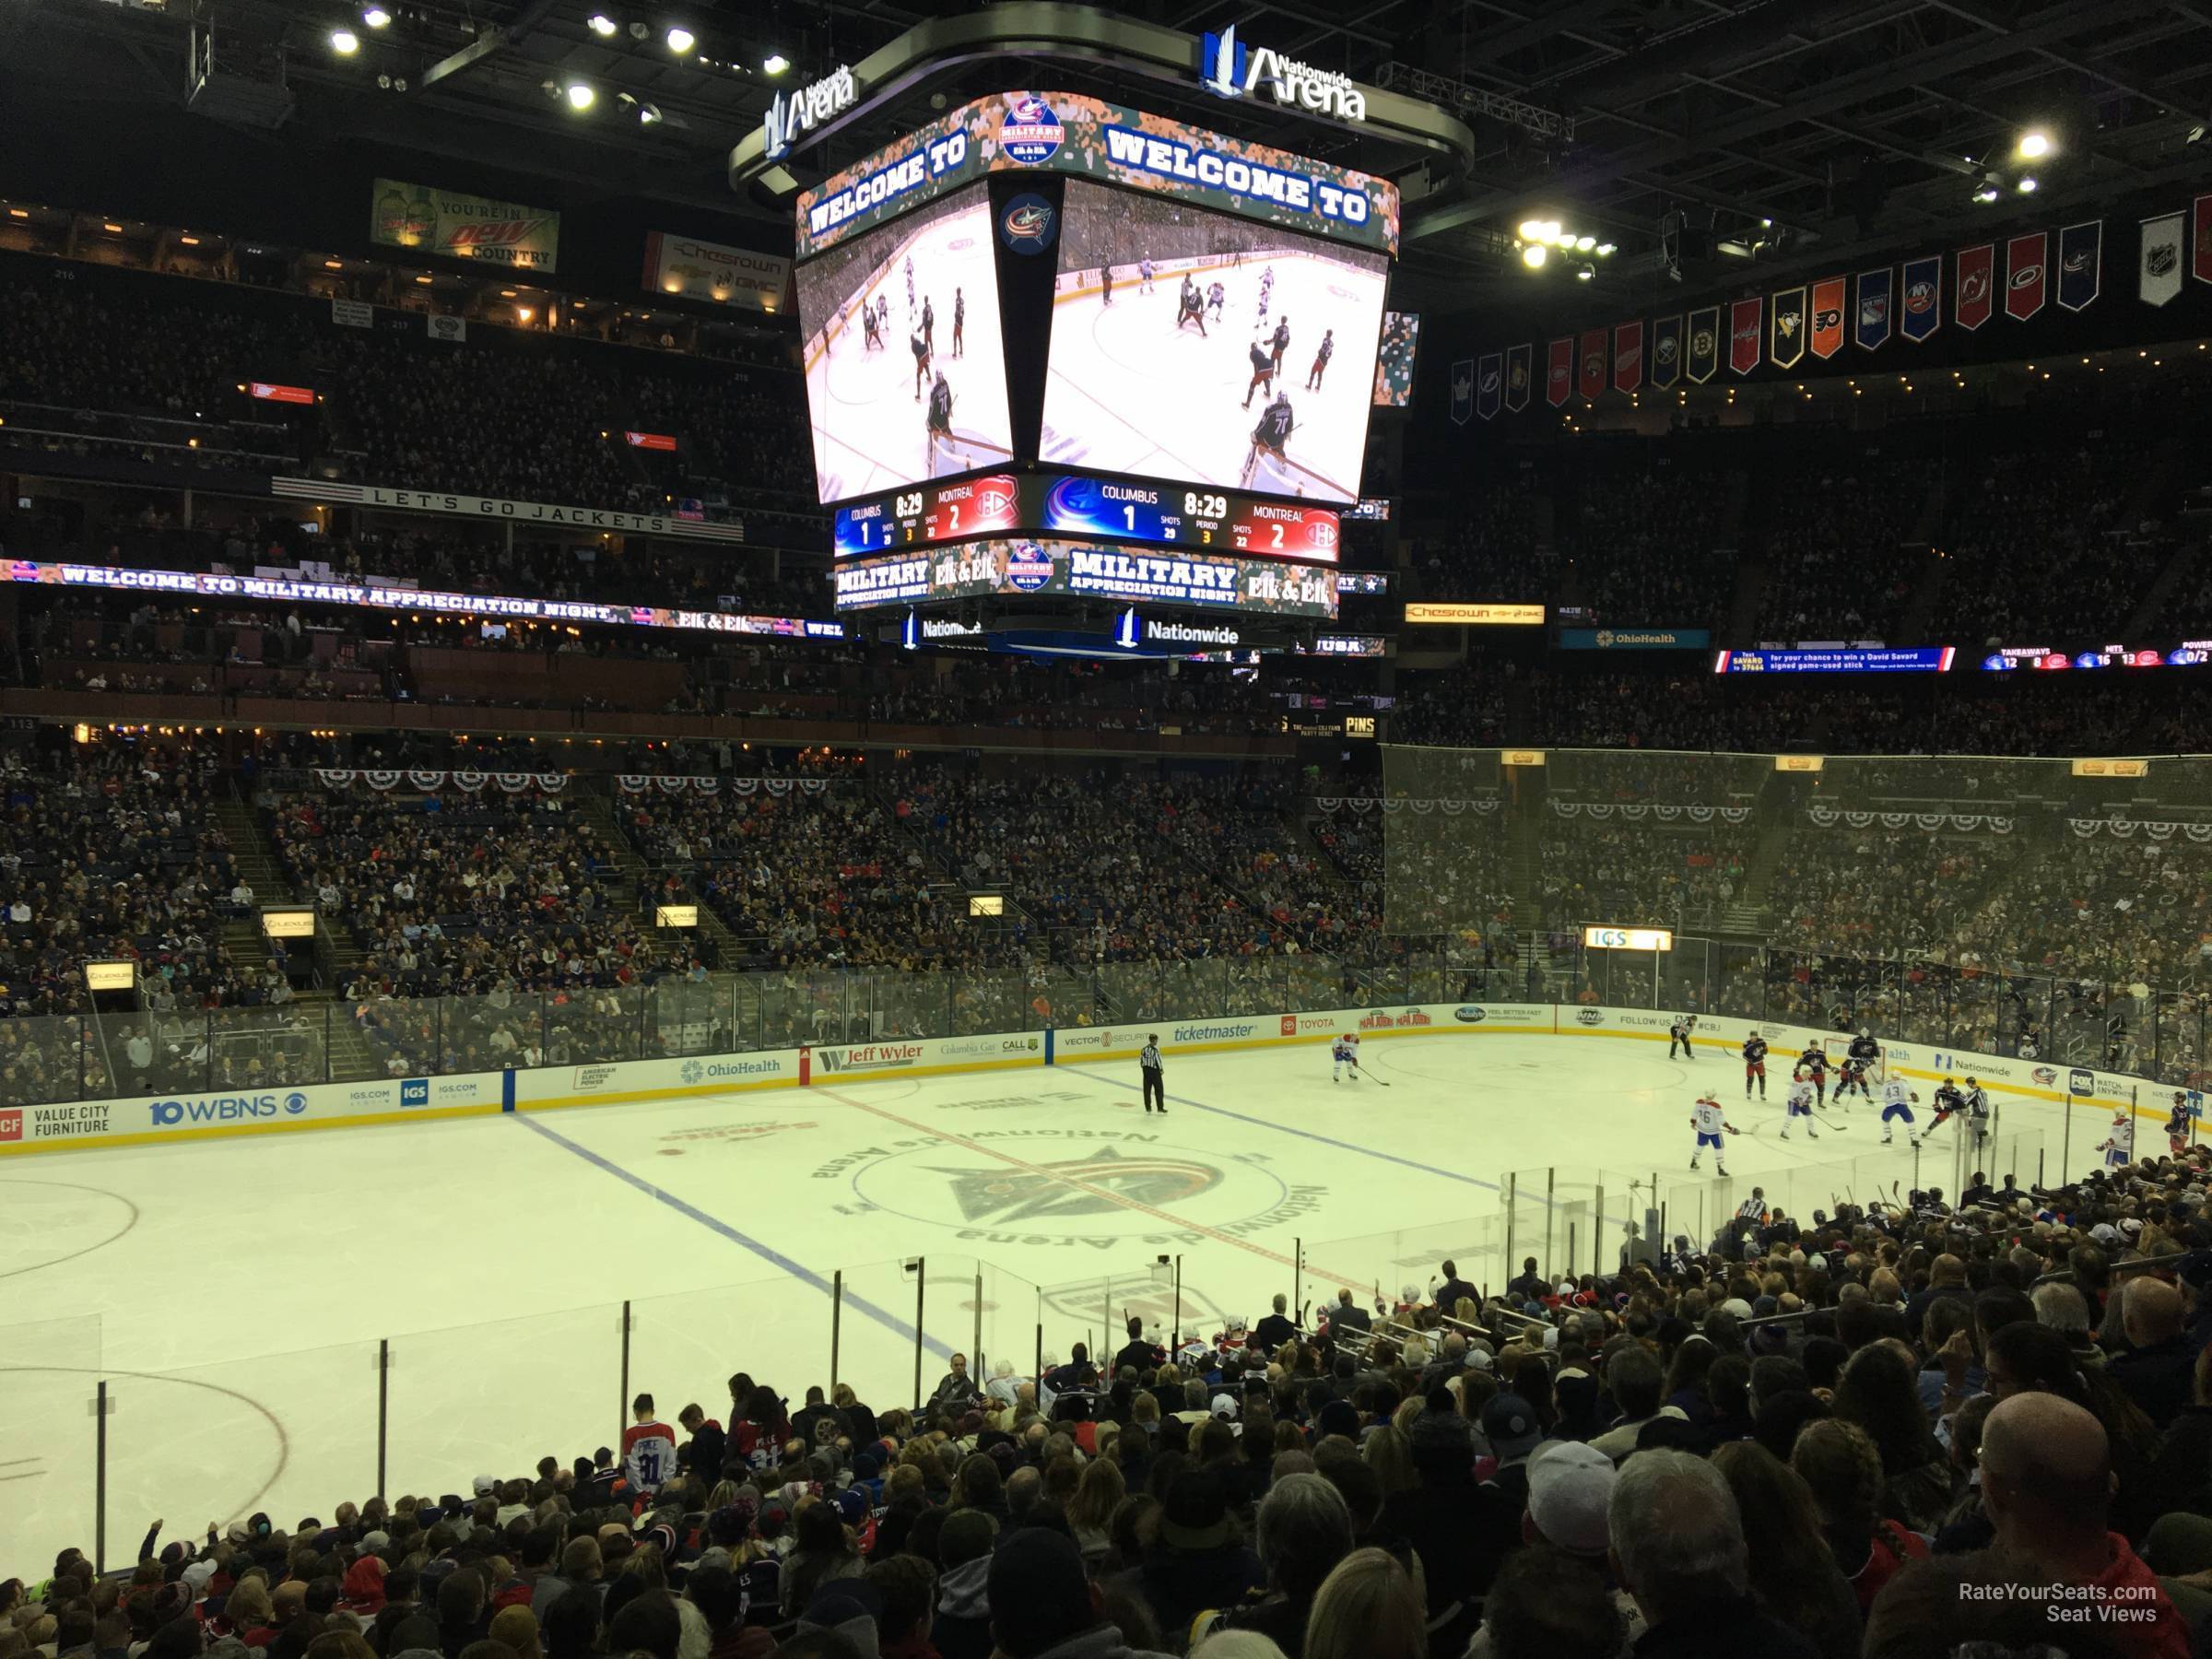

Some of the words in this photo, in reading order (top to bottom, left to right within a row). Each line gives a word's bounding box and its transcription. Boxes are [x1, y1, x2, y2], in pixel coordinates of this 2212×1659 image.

[1278, 54, 1352, 89] Nationwide
[1244, 47, 1365, 121] Arena
[786, 74, 853, 140] Arena
[811, 153, 924, 233] WELCOME
[931, 134, 965, 173] TO
[1108, 129, 1310, 207] WELCOME
[1320, 186, 1366, 222] TO
[441, 203, 498, 217] YOU'RE
[473, 246, 549, 264] COUNTRY
[374, 489, 458, 511] LET'S
[480, 500, 515, 516] GO
[532, 506, 664, 531] JACKETS
[852, 505, 881, 521] COLUMBUS
[896, 492, 922, 518] 8:29
[938, 487, 973, 503] MONTREAL
[1102, 486, 1158, 504] COLUMBUS
[1184, 492, 1227, 519] 8:29
[1253, 506, 1303, 523] MONTREAL
[862, 523, 868, 544] 1
[950, 505, 959, 530] 2
[1124, 505, 1134, 531] 1
[1161, 515, 1181, 525] SHOTS
[1196, 520, 1218, 530] PERIOD
[1233, 524, 1252, 534] SHOTS
[1271, 524, 1283, 548] 2
[907, 528, 912, 541] 3
[1164, 527, 1176, 539] 29
[1203, 531, 1210, 544] 3
[1237, 536, 1247, 547] 22
[837, 560, 928, 593] MILITARY
[935, 560, 957, 585] Elk
[959, 561, 971, 582] &
[972, 557, 996, 581] Elk
[1071, 551, 1236, 589] MILITARY
[62, 567, 196, 590] WELCOME
[203, 578, 240, 593] TO
[244, 580, 363, 602] MILITARY
[370, 590, 538, 614] APPRECIATION
[545, 603, 609, 619] NIGHT
[837, 586, 898, 604] APPRECIATION
[1070, 577, 1186, 597] APPRECIATION
[1190, 589, 1236, 603] NIGHT
[1249, 576, 1278, 599] Elk
[1281, 578, 1299, 602] &
[1301, 581, 1330, 604] Elk
[679, 612, 705, 629] Elk
[709, 615, 722, 630] &
[724, 614, 750, 631] Elk
[1148, 621, 1239, 644] Nationwide
[1616, 634, 1676, 643] OhioHealth
[2001, 648, 2050, 656] TAKEAWAYS
[2004, 658, 2018, 667] 12
[2033, 657, 2041, 667] 8
[2097, 654, 2111, 665] 16
[2123, 654, 2136, 665] 13
[2186, 652, 2207, 662] 0/2
[1798, 662, 1841, 670] game-used
[10, 719, 33, 729] 113
[1595, 931, 1626, 946] IGS
[1300, 1019, 1334, 1029] TOYOTA
[1620, 1016, 1656, 1025] FOLLOW
[1699, 1023, 1721, 1031] #CBJ
[1065, 1037, 1100, 1046] VECTOR
[1112, 1032, 1151, 1042] SECURIT
[1174, 1025, 1253, 1041] ticketmaster
[848, 1048, 876, 1064] Jeff
[880, 1045, 924, 1062] Wyler
[980, 1042, 995, 1052] Gas
[1002, 1041, 1025, 1050] CALL
[707, 1060, 781, 1077] OhioHealth
[1955, 1060, 2011, 1077] Nationwide
[404, 1087, 426, 1099] IGS
[439, 1084, 477, 1092] IGS.COM
[1887, 1087, 1900, 1097] 43
[2097, 1080, 2122, 1088] WATCH
[350, 1091, 390, 1100] IGS.COM
[35, 1108, 75, 1122] VALUE
[80, 1106, 109, 1119] CITY
[149, 1101, 183, 1125] 10
[186, 1095, 276, 1122] WBNS
[35, 1119, 109, 1135] FURNITURE
[811, 1146, 891, 1179] Arena
[956, 1230, 1118, 1250] Arena
[638, 1440, 657, 1453] PRICE
